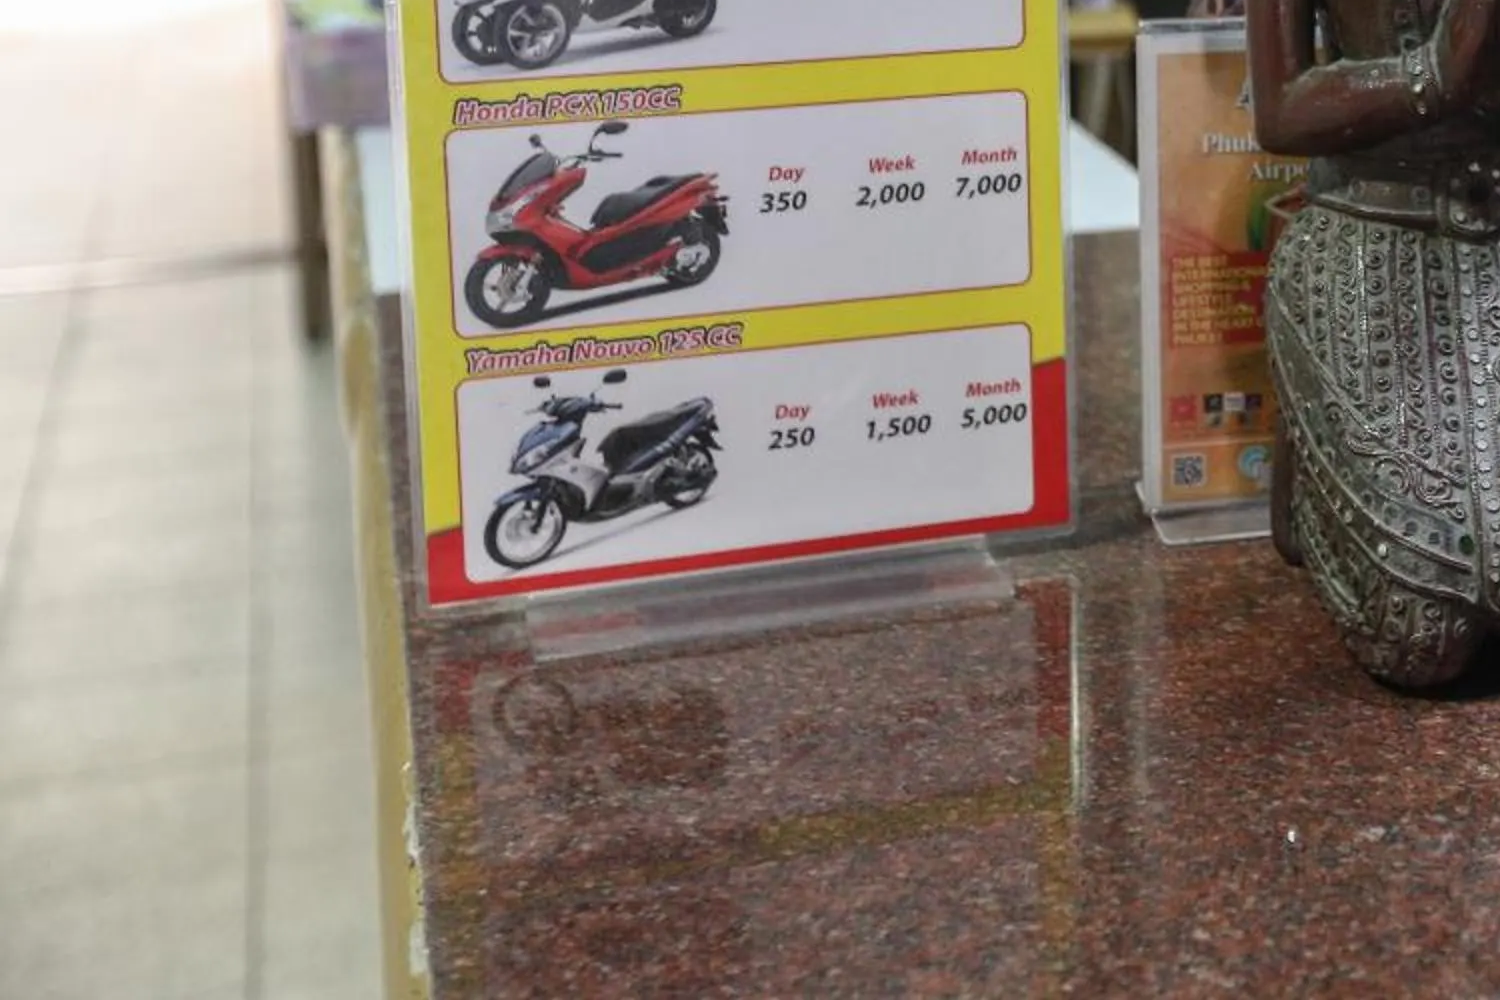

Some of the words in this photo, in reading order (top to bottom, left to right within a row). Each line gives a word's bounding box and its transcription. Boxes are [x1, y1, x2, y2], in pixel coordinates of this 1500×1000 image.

[454, 93, 543, 125] Honda
[545, 91, 600, 118] PCX
[1202, 132, 1261, 153] Phuk
[768, 165, 805, 183] Day
[868, 155, 915, 173] Week
[961, 147, 1017, 165] Month
[760, 191, 807, 213] 350
[856, 182, 925, 208] 2,000
[956, 173, 1022, 199] 7,000
[465, 340, 569, 374] Yamaha
[571, 335, 655, 363] Nouvo
[659, 327, 704, 354] 125
[775, 404, 811, 420] Day
[872, 389, 919, 408] Week
[965, 378, 1021, 398] Month
[768, 427, 815, 450] 250
[866, 414, 932, 441] 1,500
[961, 402, 1027, 429] 5,000
